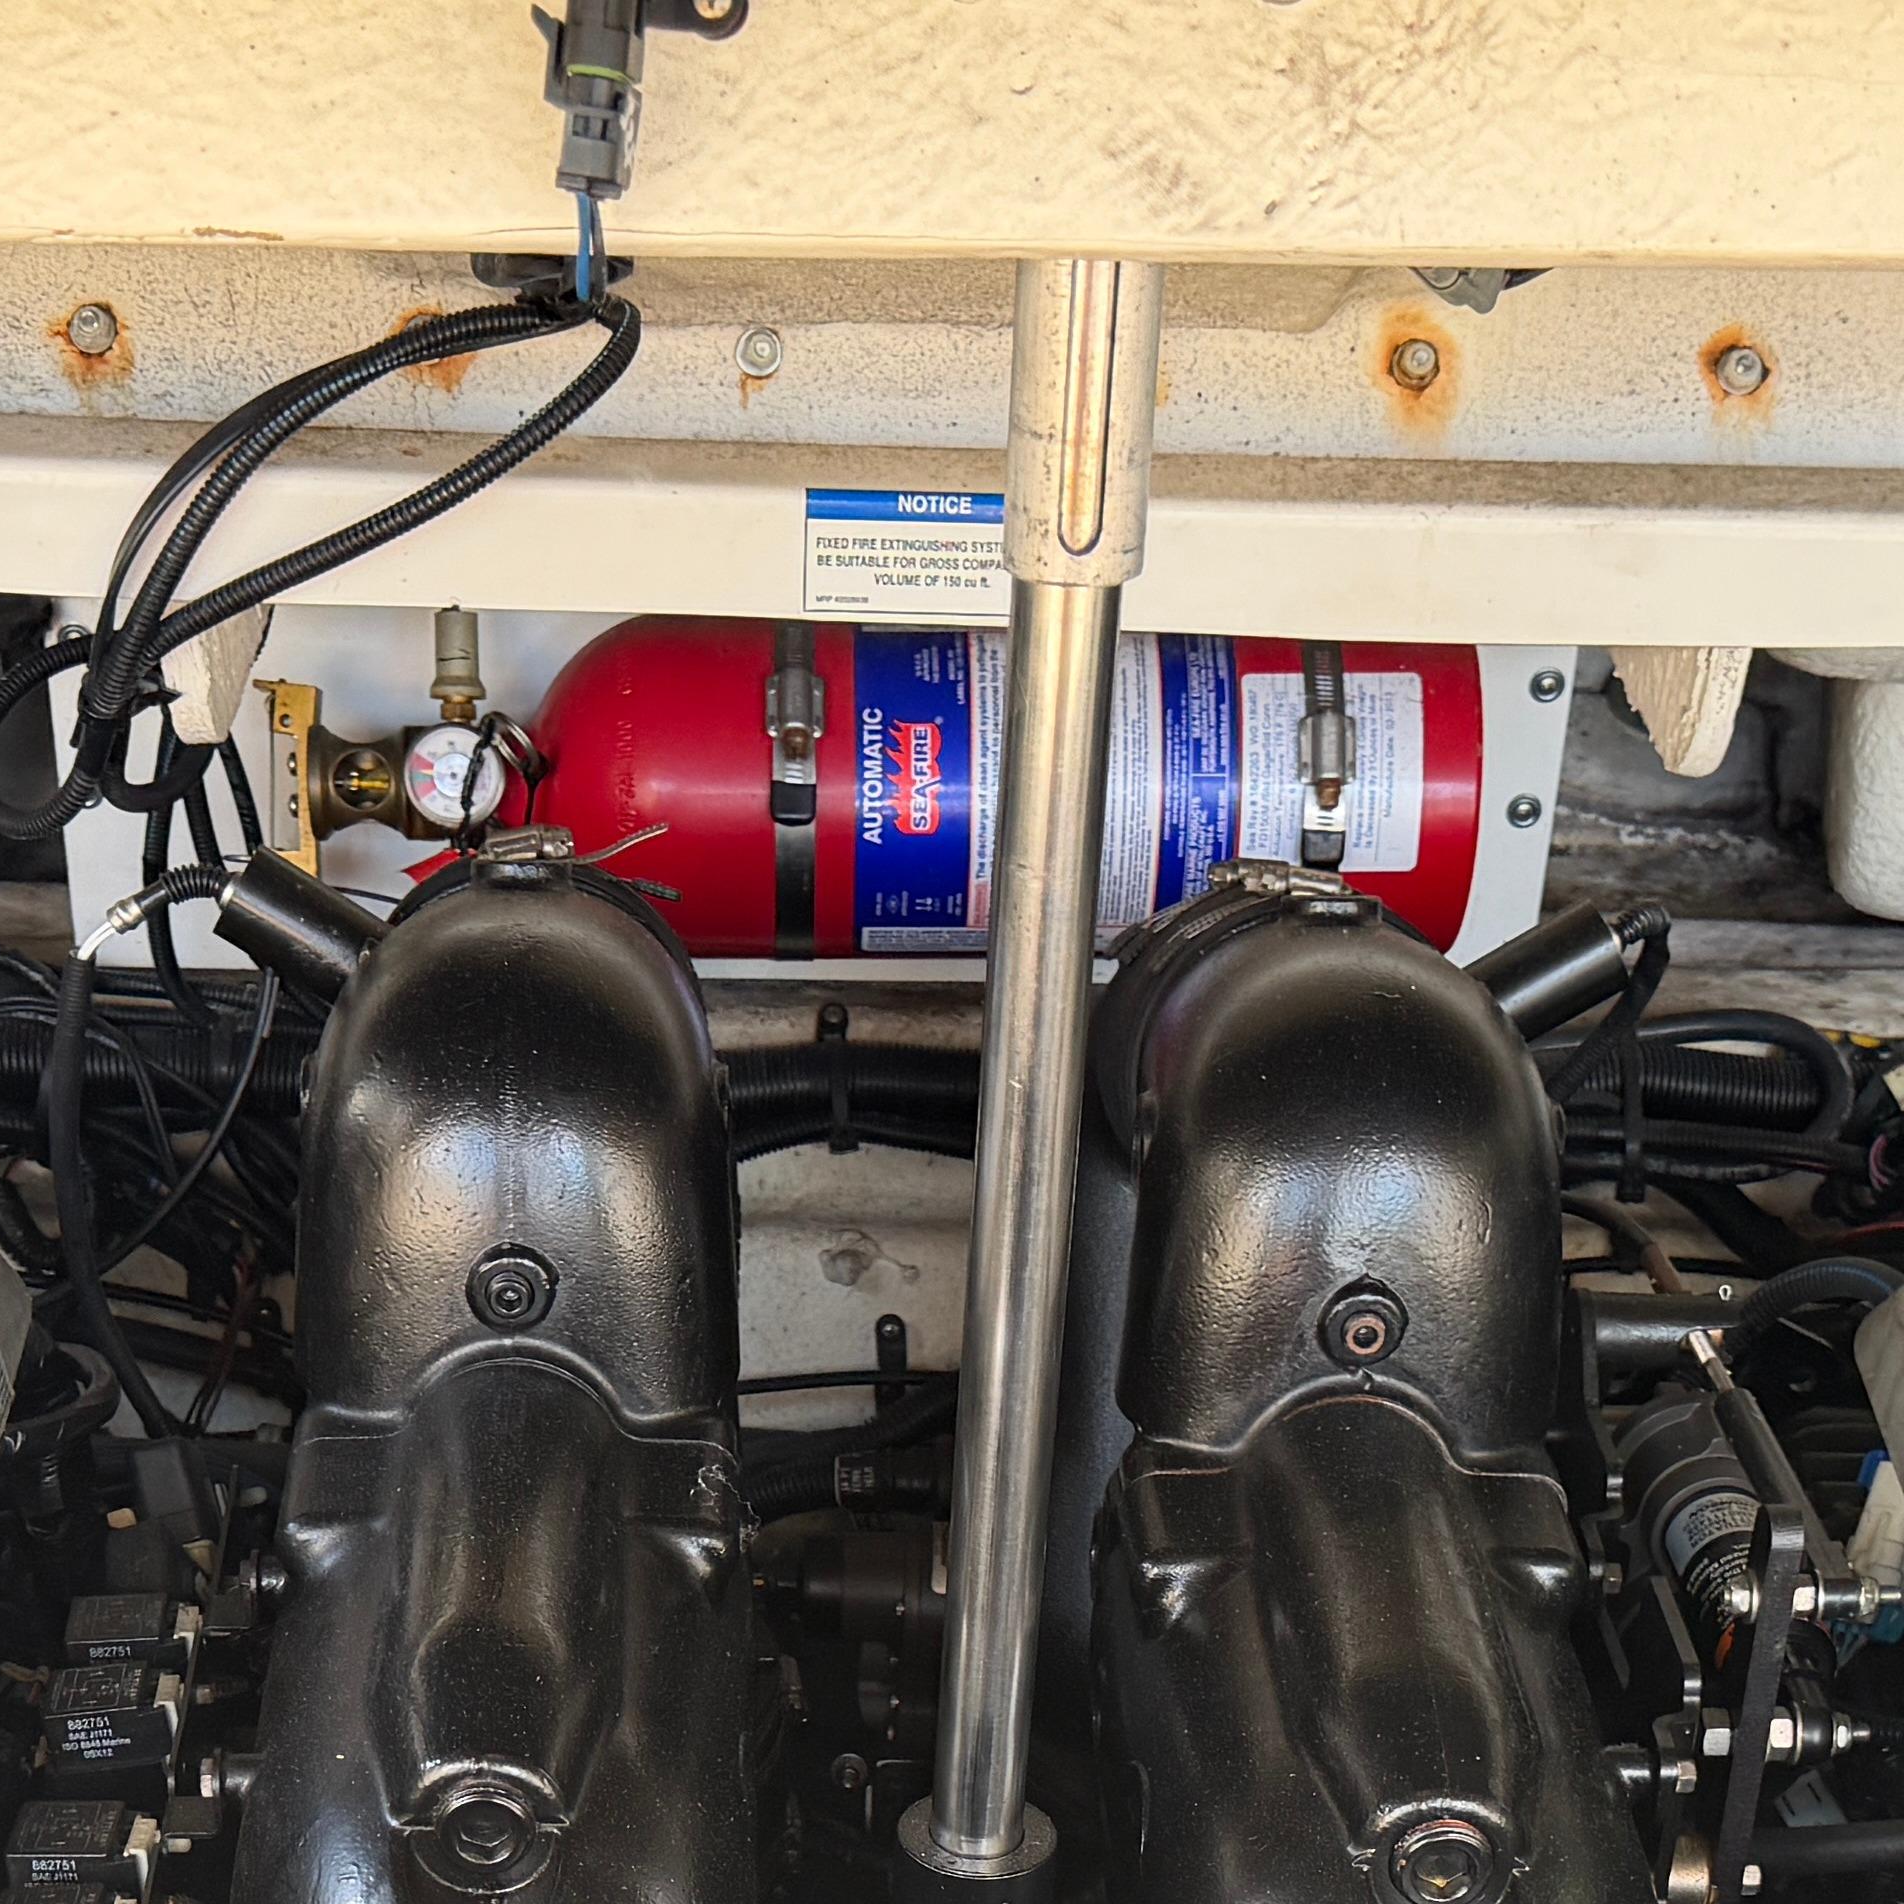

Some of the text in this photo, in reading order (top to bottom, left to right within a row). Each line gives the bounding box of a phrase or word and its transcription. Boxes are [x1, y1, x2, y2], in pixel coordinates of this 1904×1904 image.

[898, 495, 972, 514] NOTICE
[817, 538, 848, 549] FIXED
[852, 538, 877, 549] FIRE
[881, 539, 967, 553] EXTINGUISHING
[817, 555, 1004, 570] BE SUITABLE FOR GROSS COMPA
[875, 574, 921, 586] VOLUME
[924, 575, 939, 586] OF
[944, 576, 960, 587] 150
[978, 687, 989, 726] systems
[978, 730, 989, 758] agent
[863, 707, 883, 844] AUTOMATIC
[978, 762, 988, 791] clean
[978, 795, 988, 805] of
[1247, 807, 1257, 829] Ray
[977, 808, 989, 859] discharge
[1247, 832, 1256, 850] Sea
[976, 862, 987, 879] The
[89, 1646, 131, 1657] 882751
[67, 1716, 109, 1730] 882751
[32, 1860, 76, 1871] 882751
